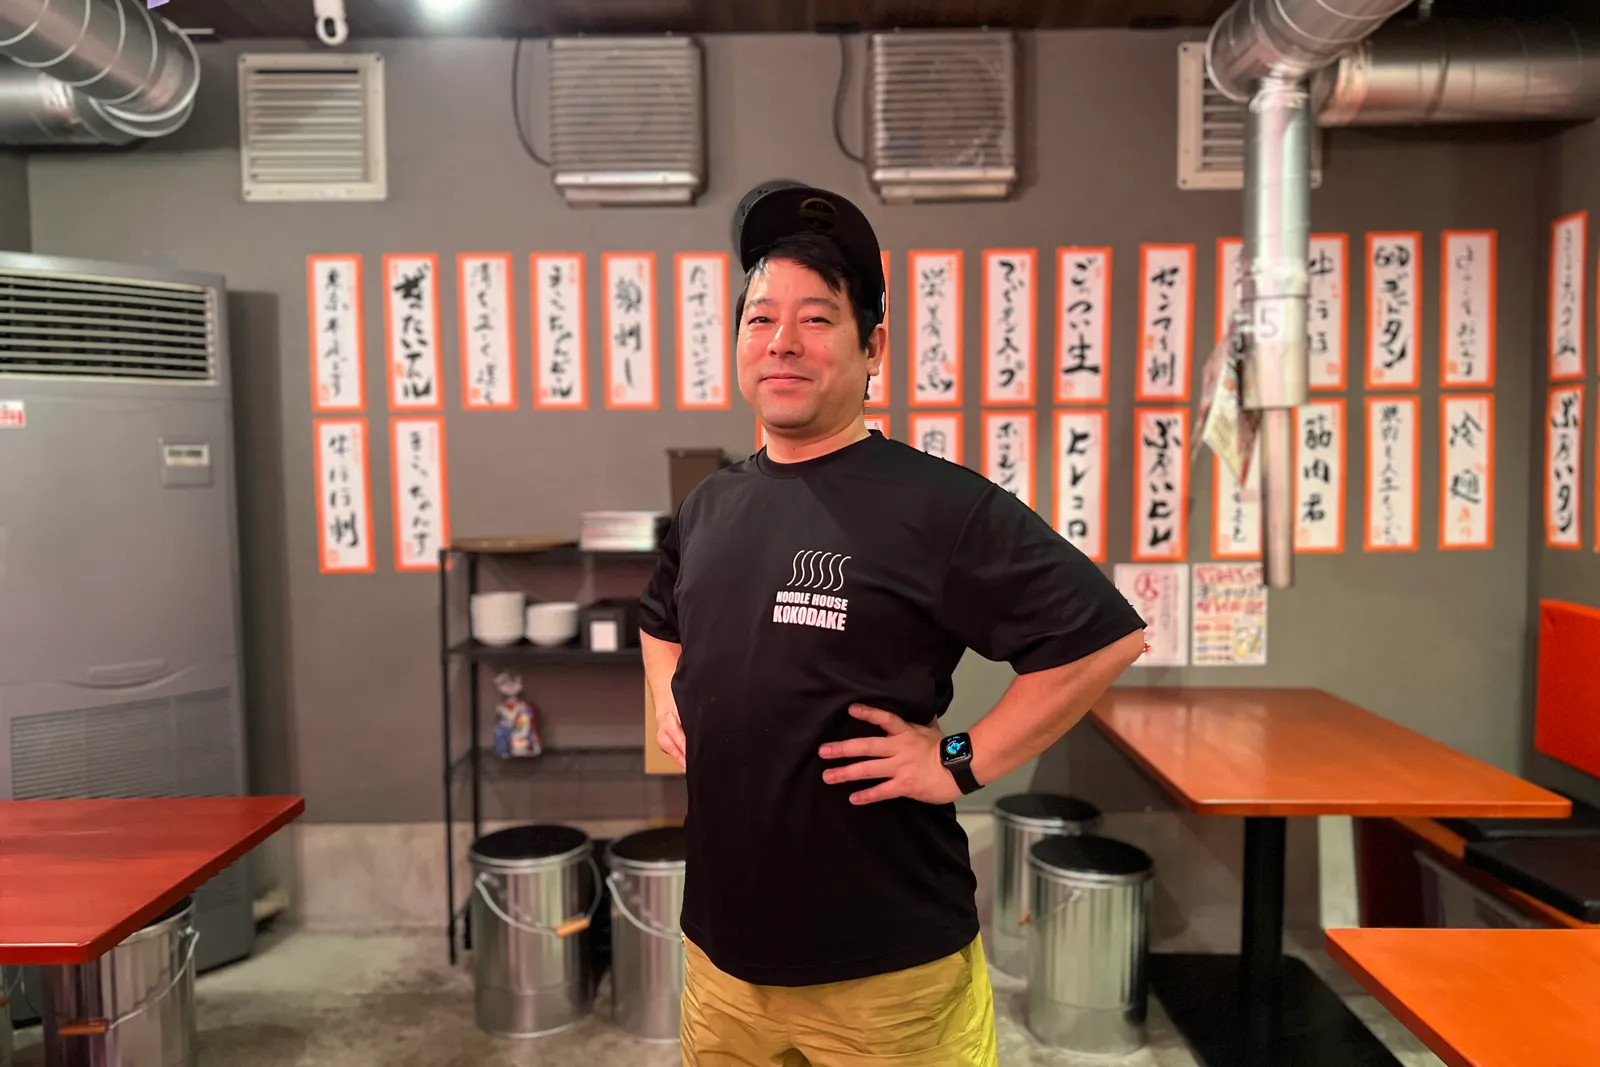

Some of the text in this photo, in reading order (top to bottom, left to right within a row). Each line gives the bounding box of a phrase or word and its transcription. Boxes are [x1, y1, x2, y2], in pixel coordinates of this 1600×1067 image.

[776, 591, 848, 611] NOODLE HOUSE
[773, 605, 847, 631] KOKODAKE
